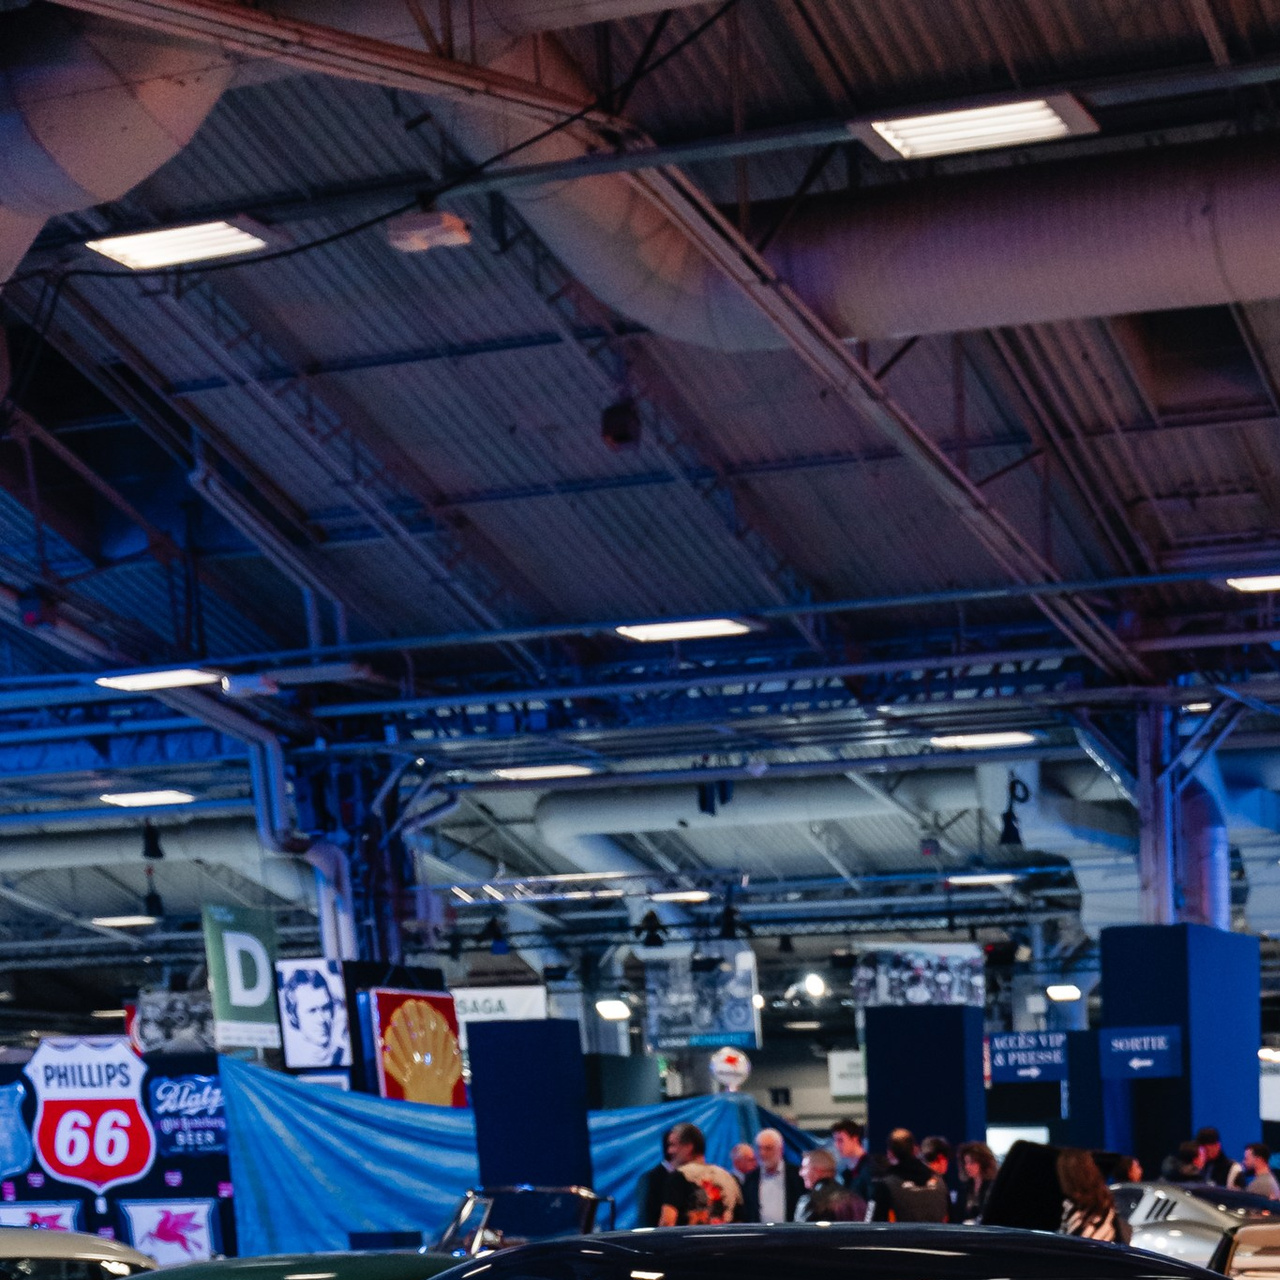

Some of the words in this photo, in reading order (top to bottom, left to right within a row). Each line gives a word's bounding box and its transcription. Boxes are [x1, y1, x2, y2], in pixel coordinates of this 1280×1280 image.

[222, 930, 272, 1008] D
[993, 1031, 1037, 1050] ACCÈS
[1039, 1032, 1066, 1048] VIP
[1111, 1036, 1168, 1052] SORTIE
[993, 1052, 1006, 1067] &
[1008, 1049, 1064, 1066] PRESSE
[44, 1062, 130, 1088] PHILLIPS
[54, 1109, 131, 1167] 66
[175, 1129, 215, 1146] BEER
